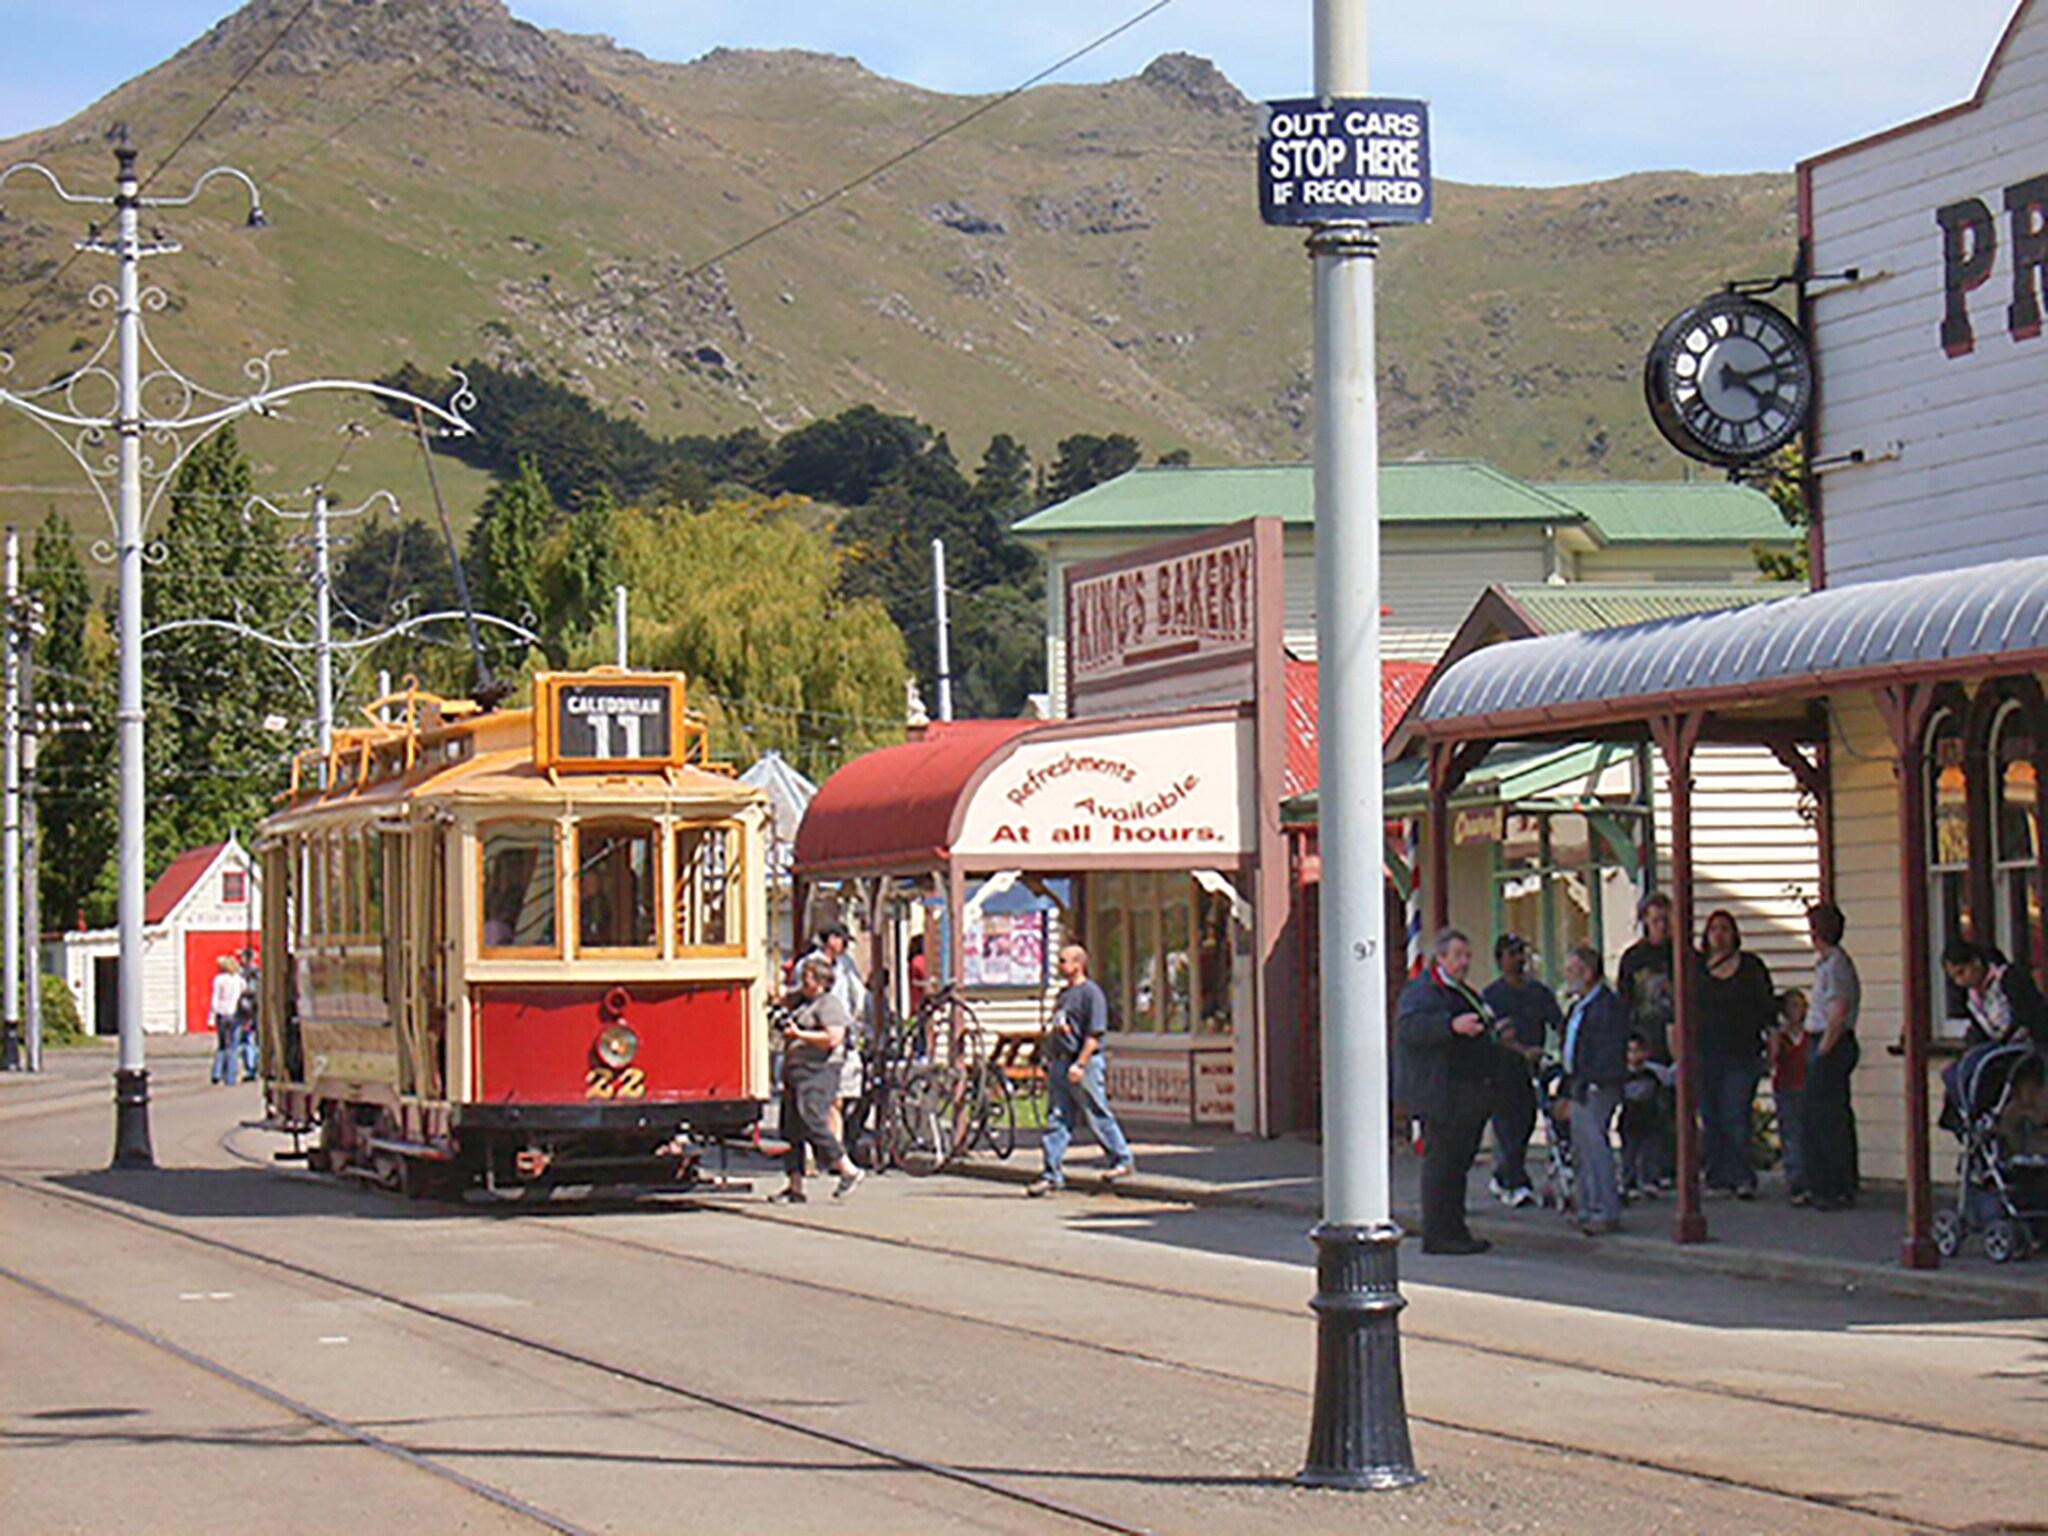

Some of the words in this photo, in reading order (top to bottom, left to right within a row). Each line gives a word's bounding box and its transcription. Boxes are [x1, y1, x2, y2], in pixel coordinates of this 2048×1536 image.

[1271, 112, 1334, 138] OUT
[1345, 112, 1421, 138] CARS
[1270, 138, 1346, 179] STOP
[1356, 138, 1420, 177] HERE
[1273, 182, 1293, 205] IF
[1303, 180, 1423, 206] REQUIRED
[1157, 544, 1250, 640] BAKERY
[587, 715, 641, 759] 11
[1006, 752, 1137, 806] Refreshments
[1074, 773, 1199, 822] Available
[991, 825, 1031, 843] At
[1051, 824, 1090, 843] all
[1112, 825, 1225, 843] hours.
[585, 1067, 646, 1099] 22
